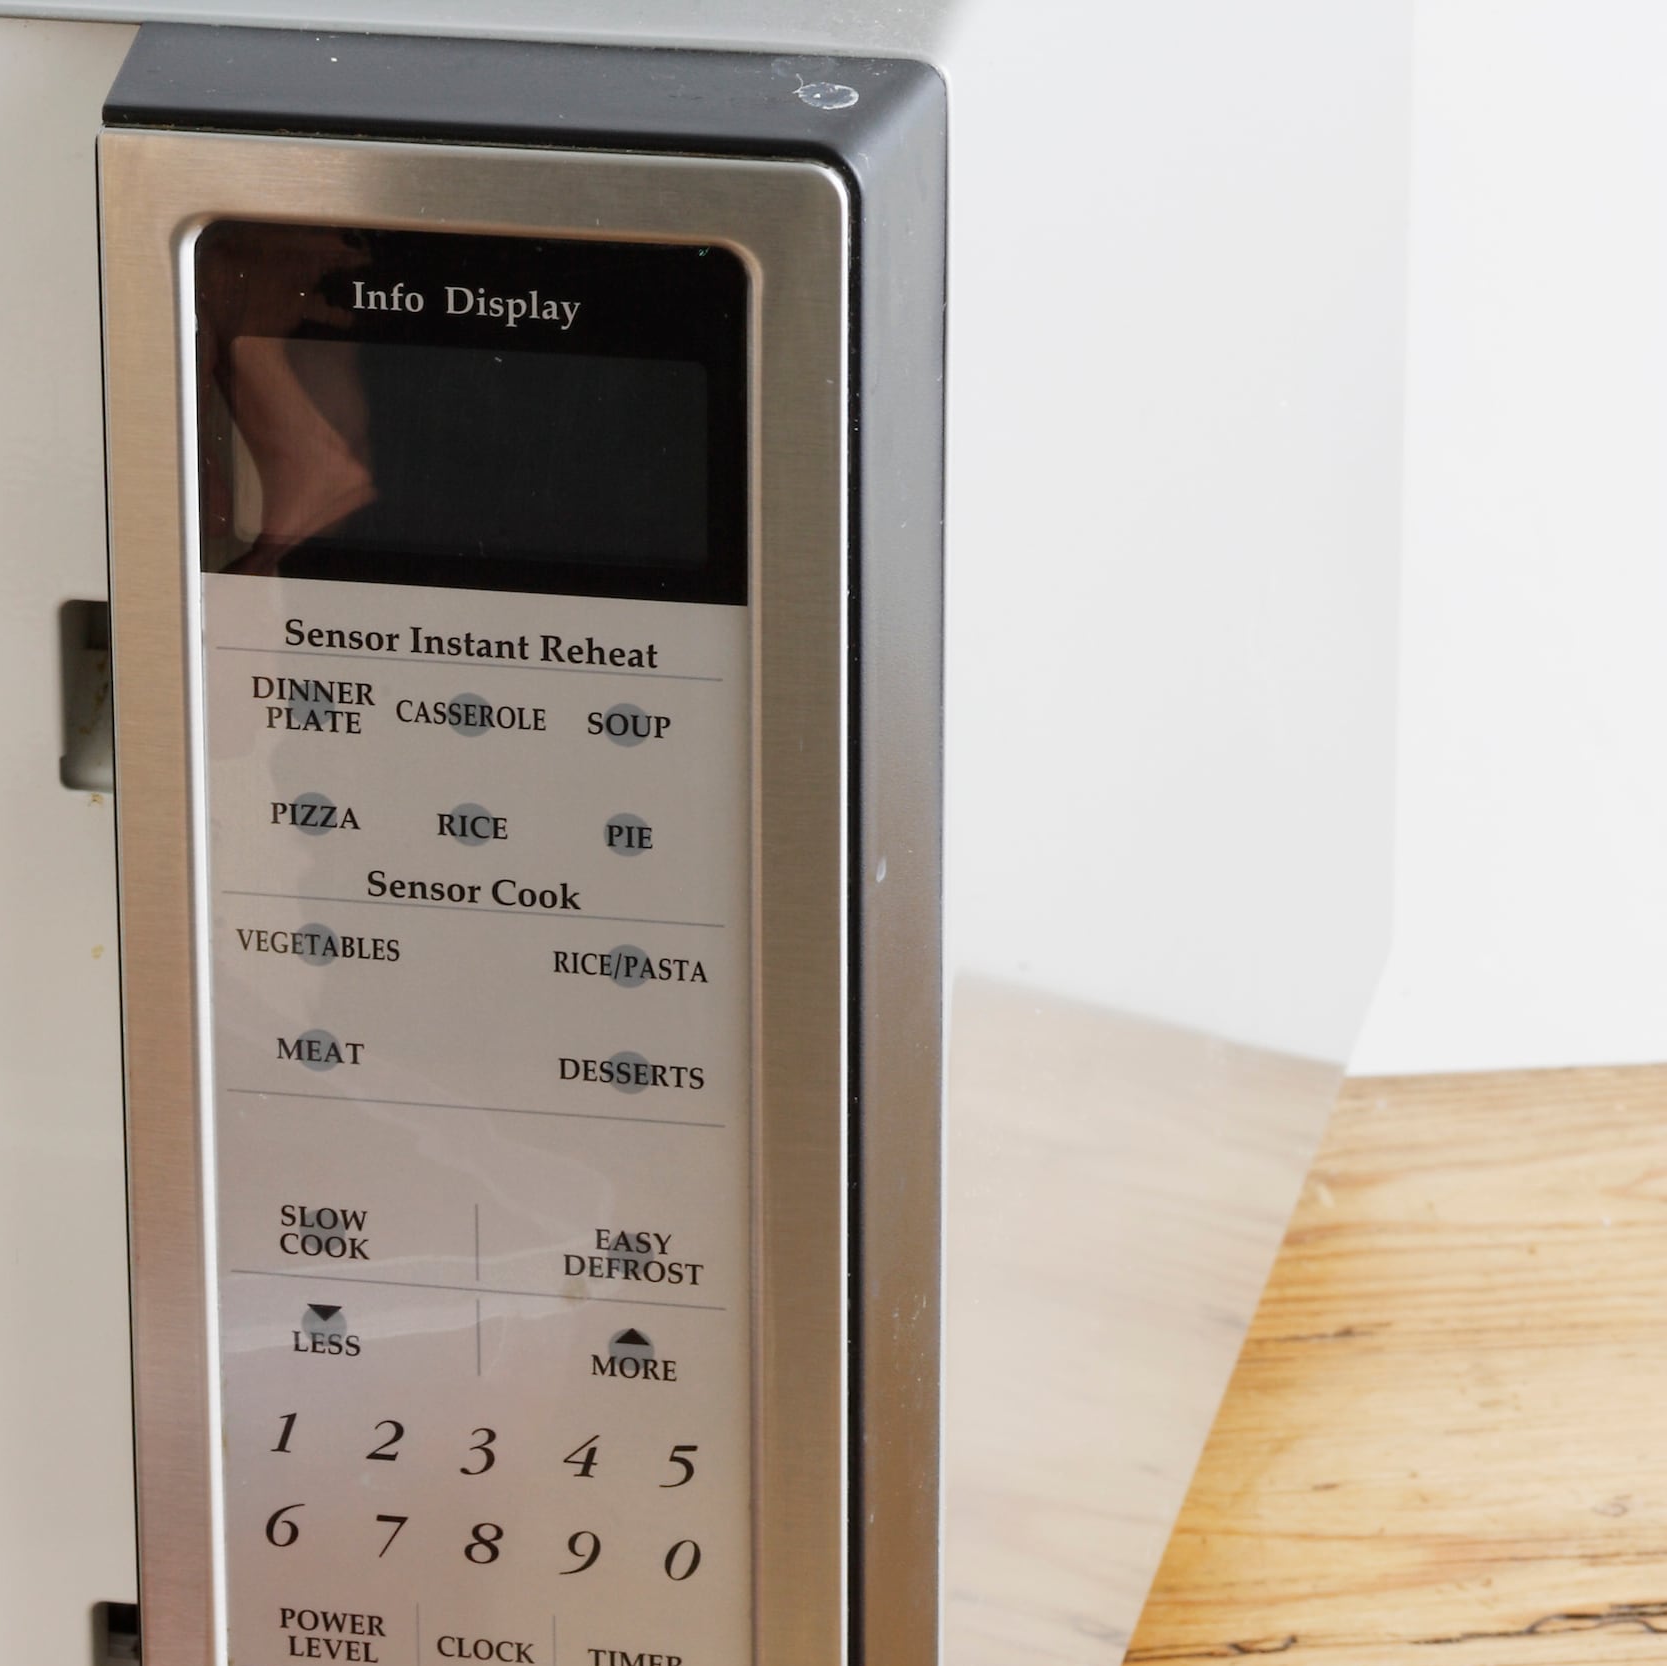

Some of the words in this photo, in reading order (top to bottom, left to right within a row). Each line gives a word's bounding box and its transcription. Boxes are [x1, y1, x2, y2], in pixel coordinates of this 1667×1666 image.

[353, 281, 424, 312] Info
[445, 287, 580, 330] Display
[286, 619, 399, 652] Sensor
[410, 627, 529, 660] Instant
[540, 635, 658, 668] Reheat
[252, 676, 375, 706] DINNER
[267, 707, 361, 734] PLATE
[396, 700, 546, 731] CASSEROLE
[588, 712, 671, 738] SOUP
[272, 803, 360, 830] PIZZA
[438, 814, 508, 840] RICE
[607, 825, 653, 849] PIE
[368, 870, 481, 903] Sensor
[492, 879, 581, 910] Cook
[237, 929, 400, 962] VEGETABLES
[554, 951, 707, 983] RICE/PASTA
[277, 1038, 364, 1064] MEAT
[559, 1058, 704, 1089] DESSERTS
[281, 1205, 367, 1231] SLOW
[280, 1233, 369, 1260] COOK
[596, 1229, 671, 1255] EASY
[564, 1255, 704, 1285] DEFROST
[294, 1331, 360, 1356] LESS
[592, 1355, 677, 1382] MORE
[271, 1413, 297, 1453] 1
[366, 1420, 404, 1461] 2
[460, 1428, 496, 1475] 3
[563, 1435, 599, 1478] 4
[660, 1445, 698, 1488] 5
[266, 1504, 305, 1547] 6
[376, 1515, 408, 1557] 7
[464, 1523, 503, 1564] 8
[560, 1531, 601, 1575] 9
[665, 1540, 701, 1581] 0
[281, 1608, 385, 1637] POWER
[289, 1636, 378, 1663] LEVEL
[437, 1636, 534, 1664] CLOCK
